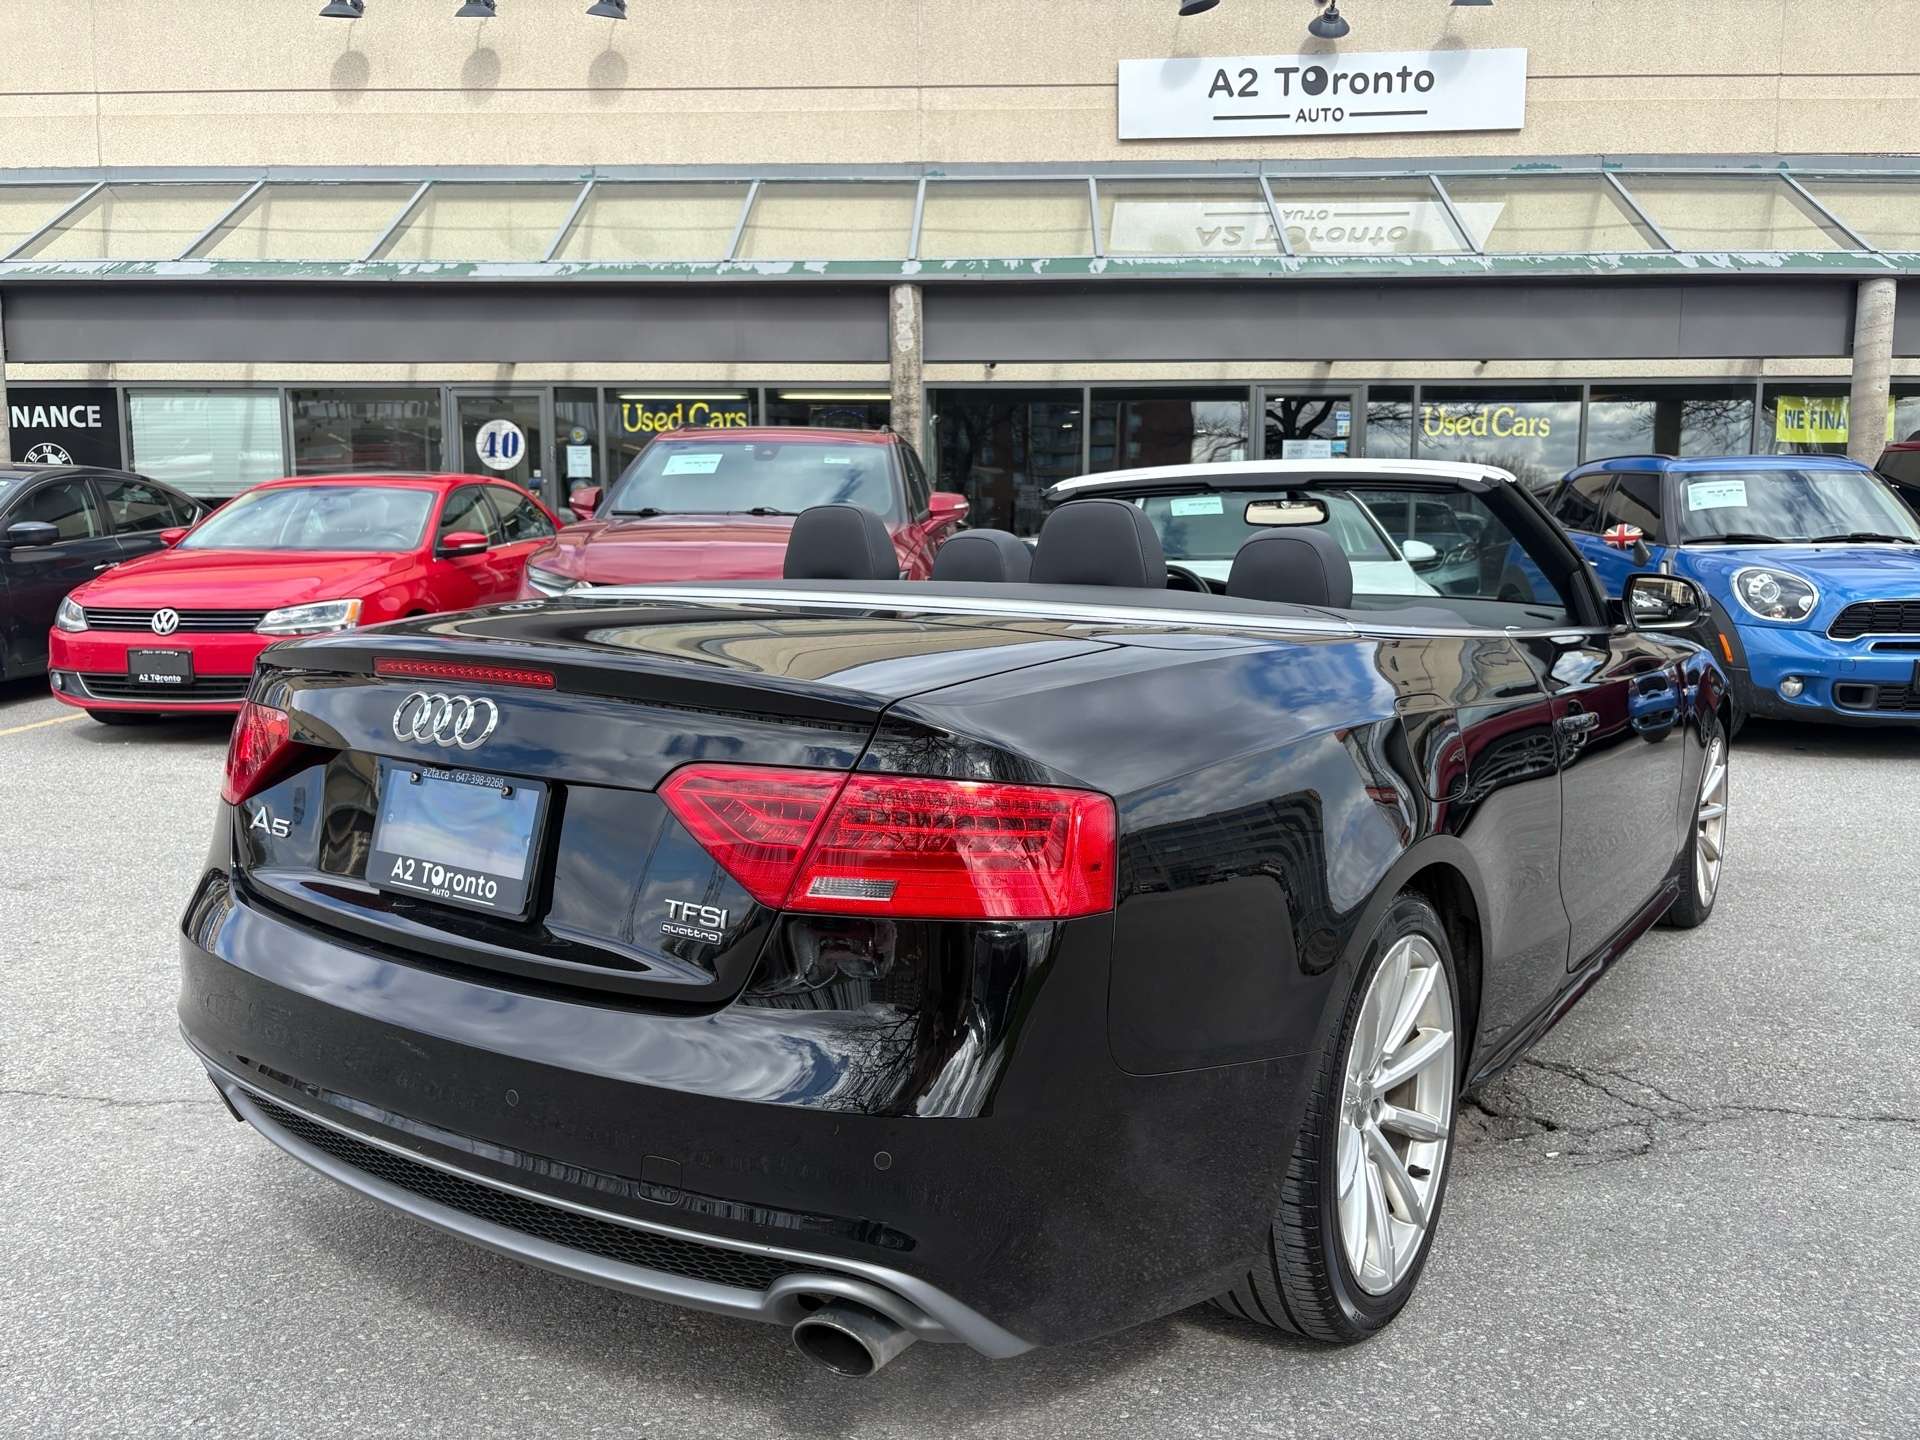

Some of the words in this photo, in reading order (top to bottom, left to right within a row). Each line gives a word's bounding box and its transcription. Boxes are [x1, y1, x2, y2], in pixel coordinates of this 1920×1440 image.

[1208, 68, 1259, 98] A2
[1295, 107, 1344, 123] AUTO
[622, 403, 683, 432] Used
[688, 402, 747, 429] Cars
[1423, 406, 1489, 437] Used
[1491, 406, 1551, 437] Cars
[1784, 409, 1805, 429] WE
[481, 431, 519, 459] 40
[455, 773, 504, 788] 647-398-9268
[249, 806, 290, 838] A5
[391, 857, 415, 881] A2
[431, 887, 450, 898] AUTO
[664, 898, 729, 930] TFSI
[662, 924, 718, 941] quattro
